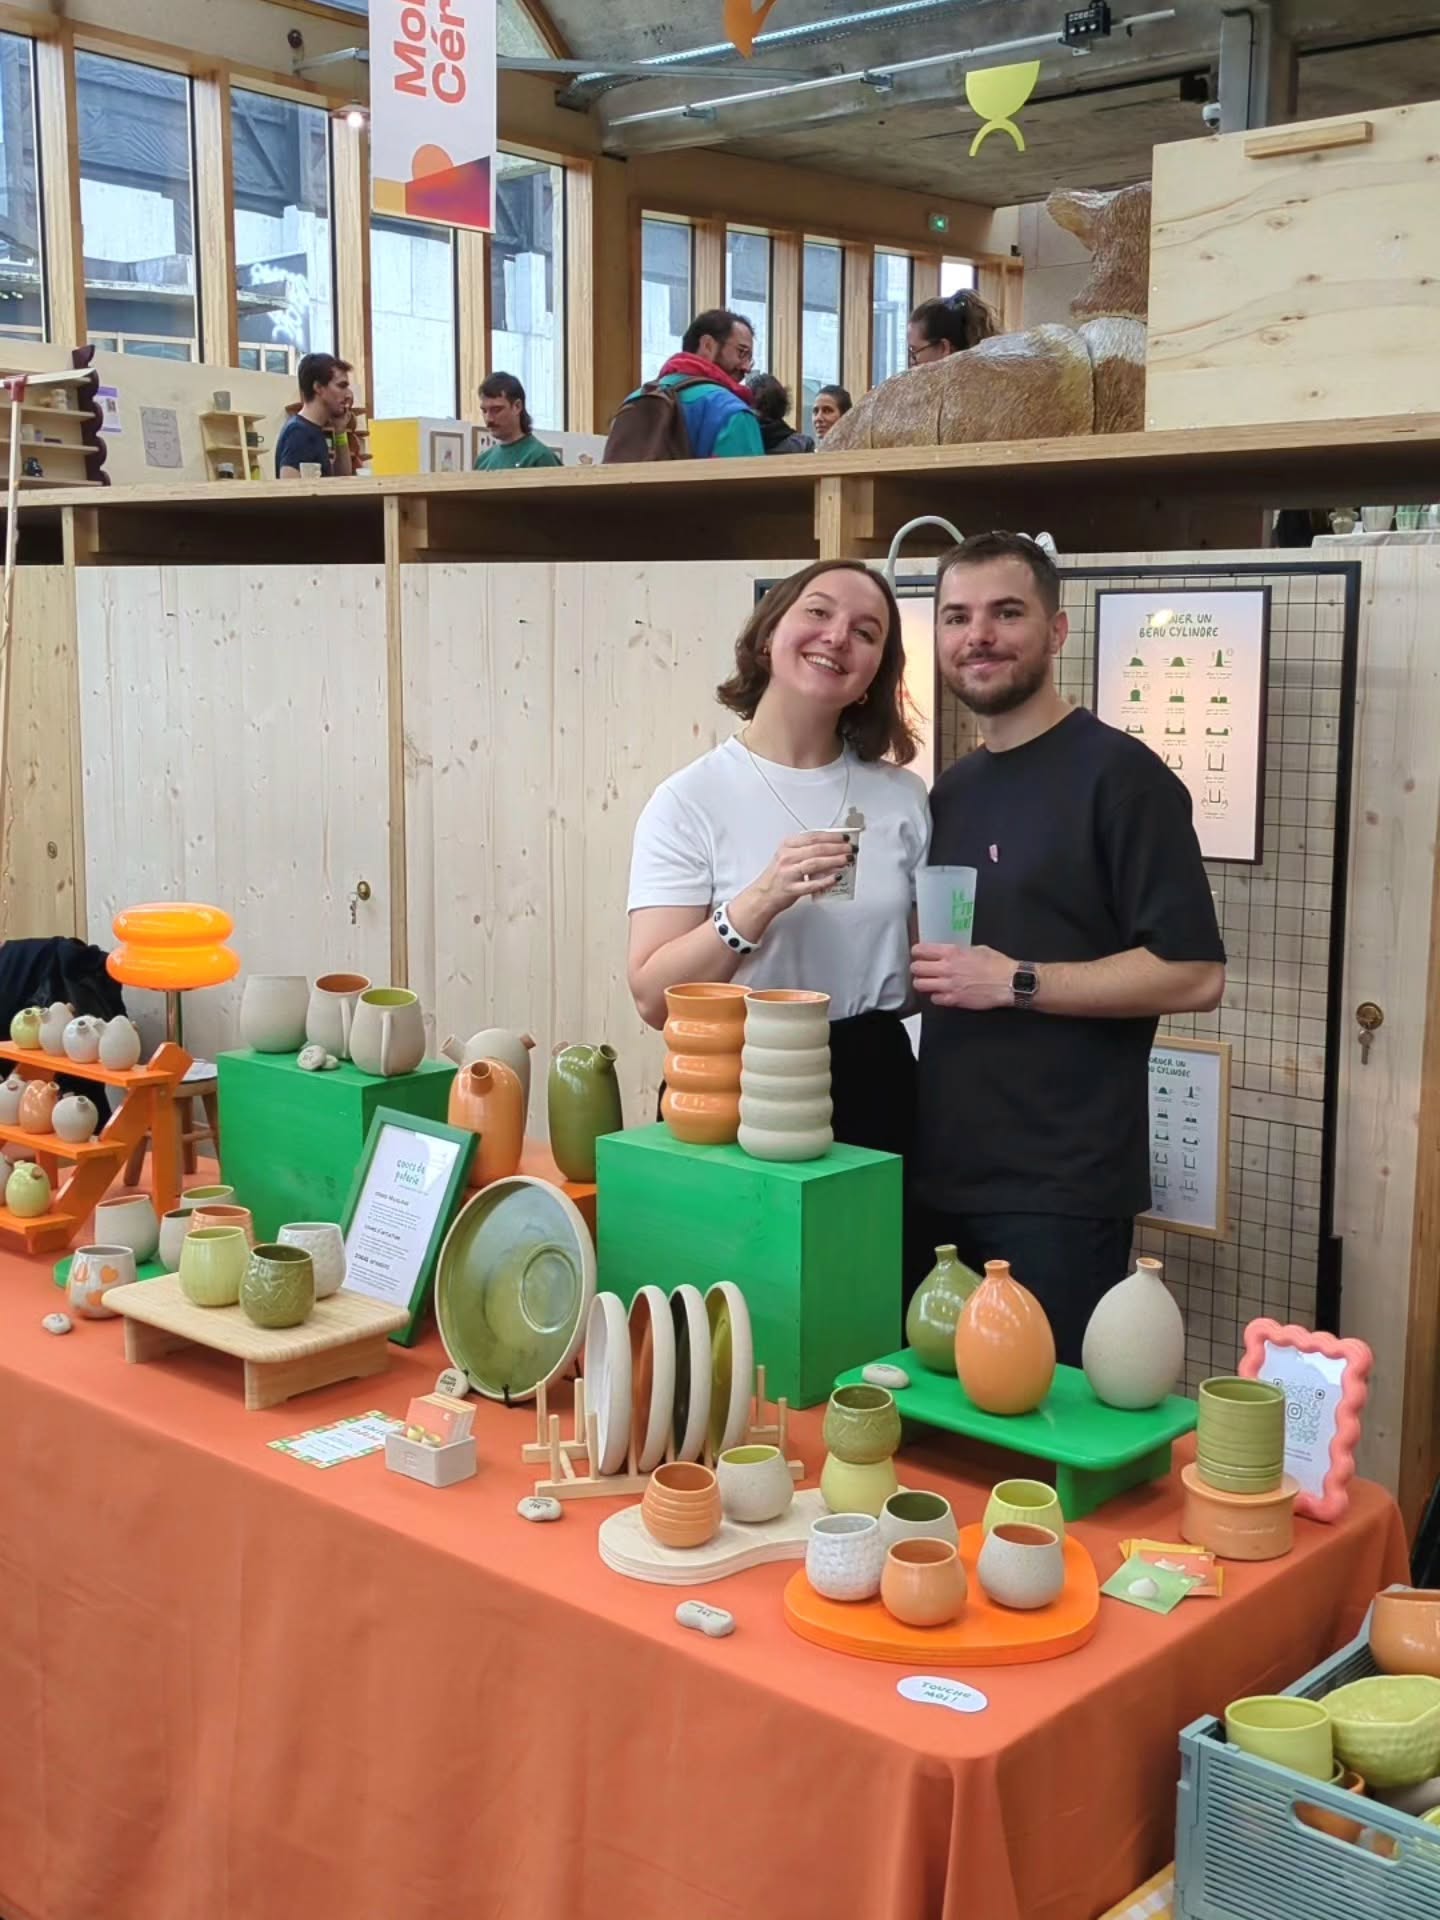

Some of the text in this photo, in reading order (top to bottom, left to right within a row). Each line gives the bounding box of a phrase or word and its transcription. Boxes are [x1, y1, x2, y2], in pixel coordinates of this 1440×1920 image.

[394, 0, 426, 96] Mo
[1197, 613, 1212, 623] UN
[1139, 626, 1219, 638] BEAU CYLINDRE
